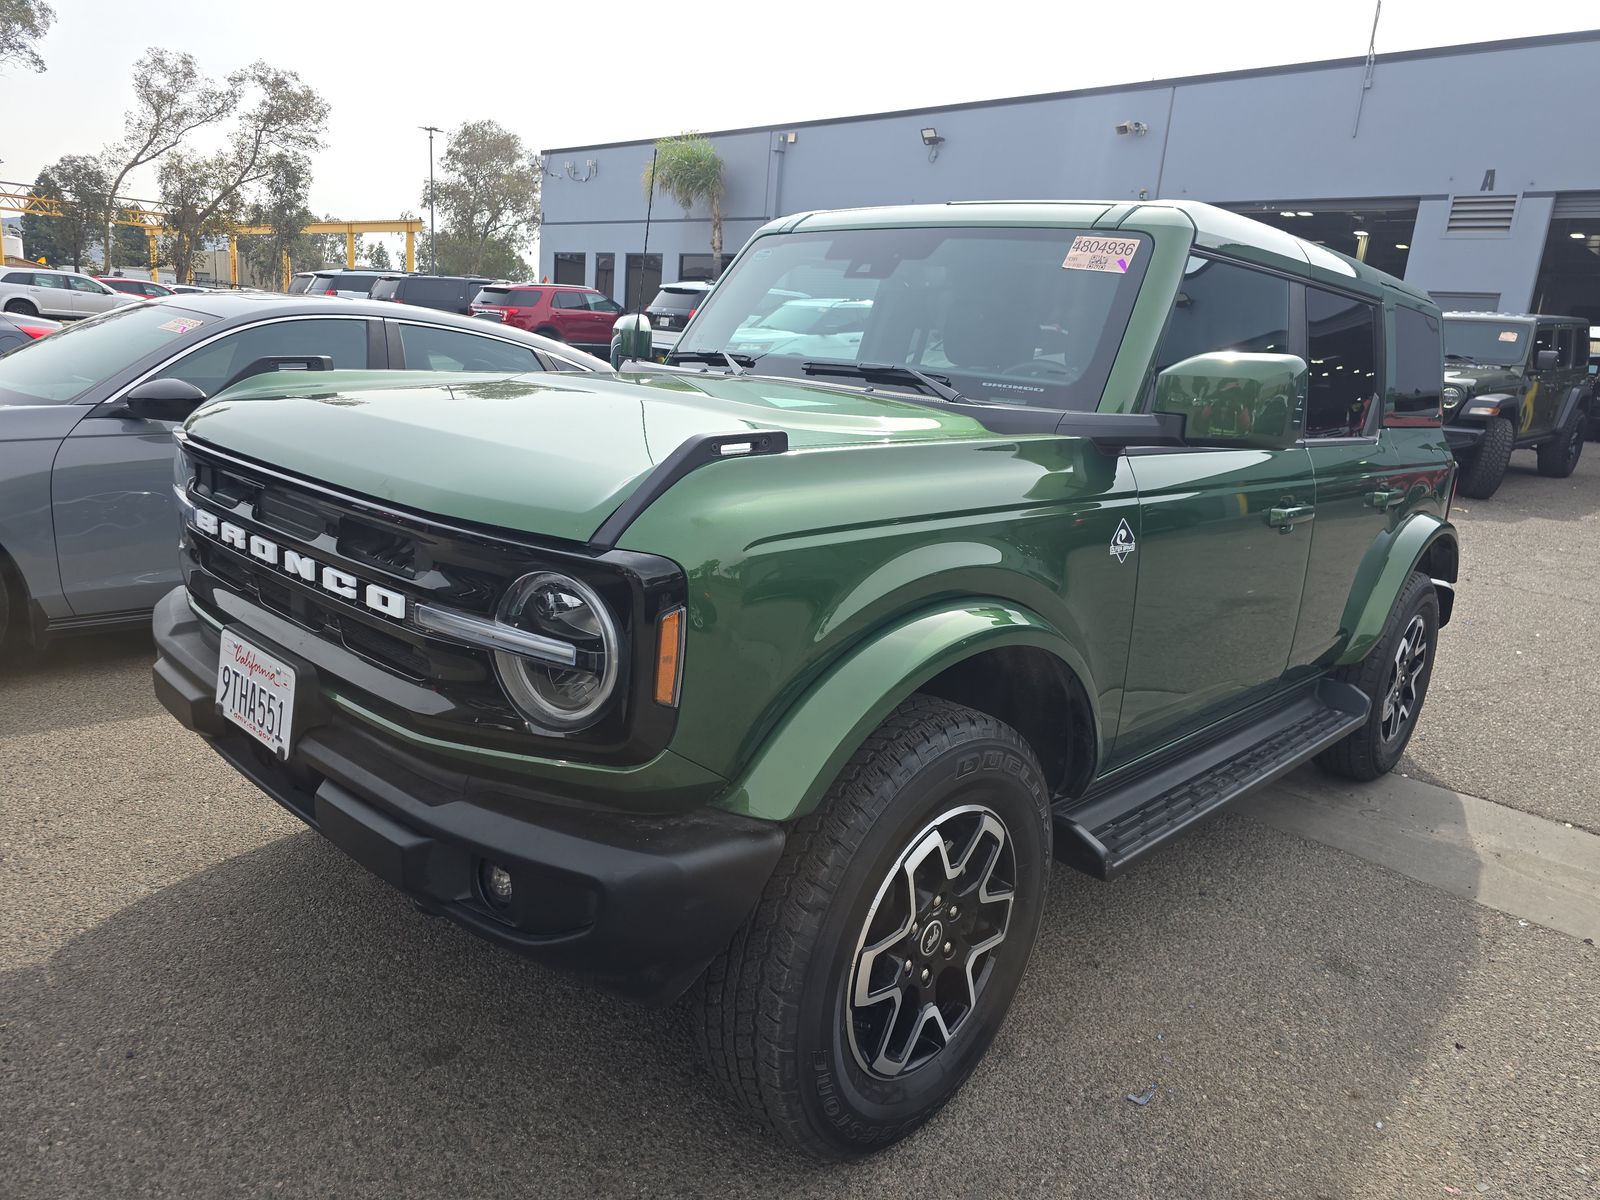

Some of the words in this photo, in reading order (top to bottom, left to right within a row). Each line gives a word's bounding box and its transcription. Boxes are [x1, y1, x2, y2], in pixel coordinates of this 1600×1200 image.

[1480, 169, 1496, 191] A
[1072, 240, 1135, 256] 4804936
[196, 508, 406, 619] BRONCO
[235, 644, 280, 687] California
[220, 665, 284, 743] 9THA551
[233, 711, 272, 741] dmv.ca.gov
